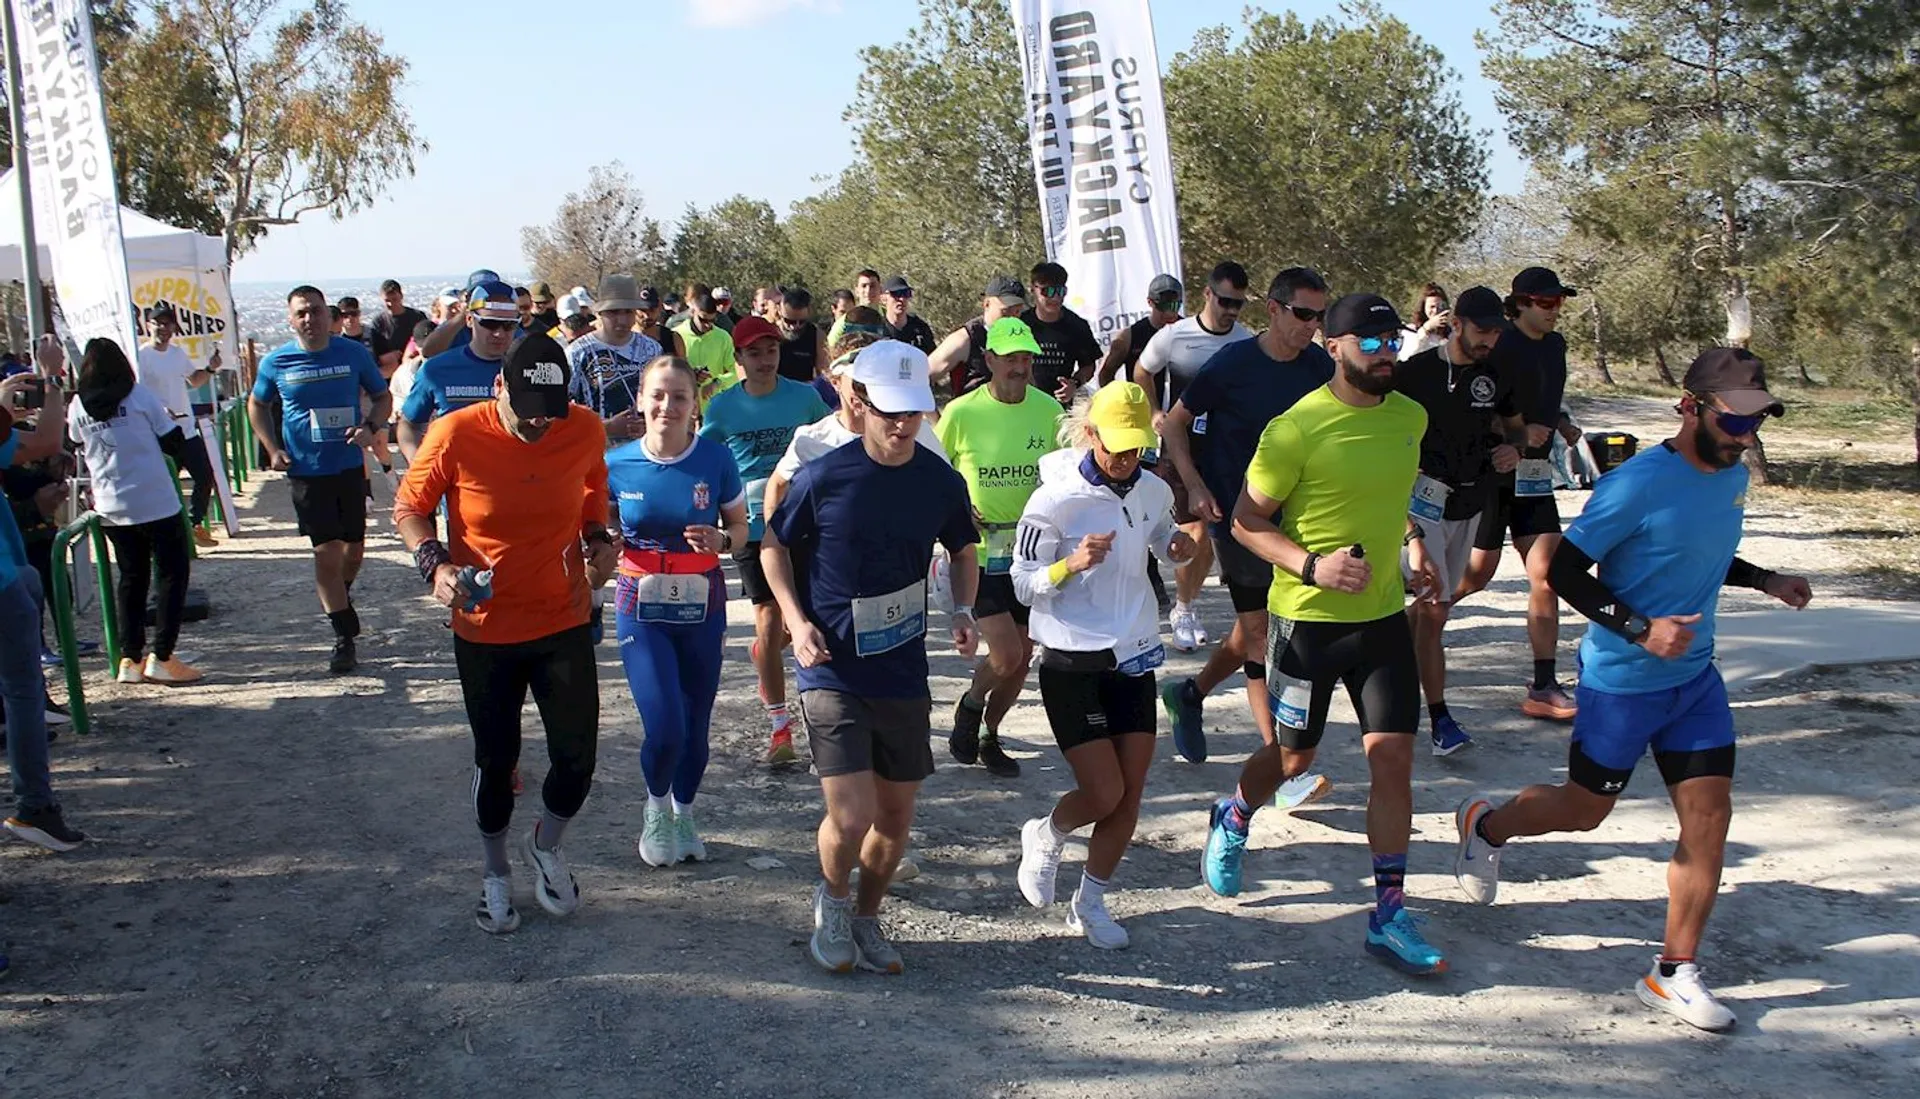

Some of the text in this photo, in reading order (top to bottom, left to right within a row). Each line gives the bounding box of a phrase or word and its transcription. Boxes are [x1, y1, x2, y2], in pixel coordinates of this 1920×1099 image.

[535, 362, 552, 370] THE
[978, 478, 1039, 488] RUNNING CLU
[670, 585, 679, 597] 3
[886, 604, 901, 620] 51
